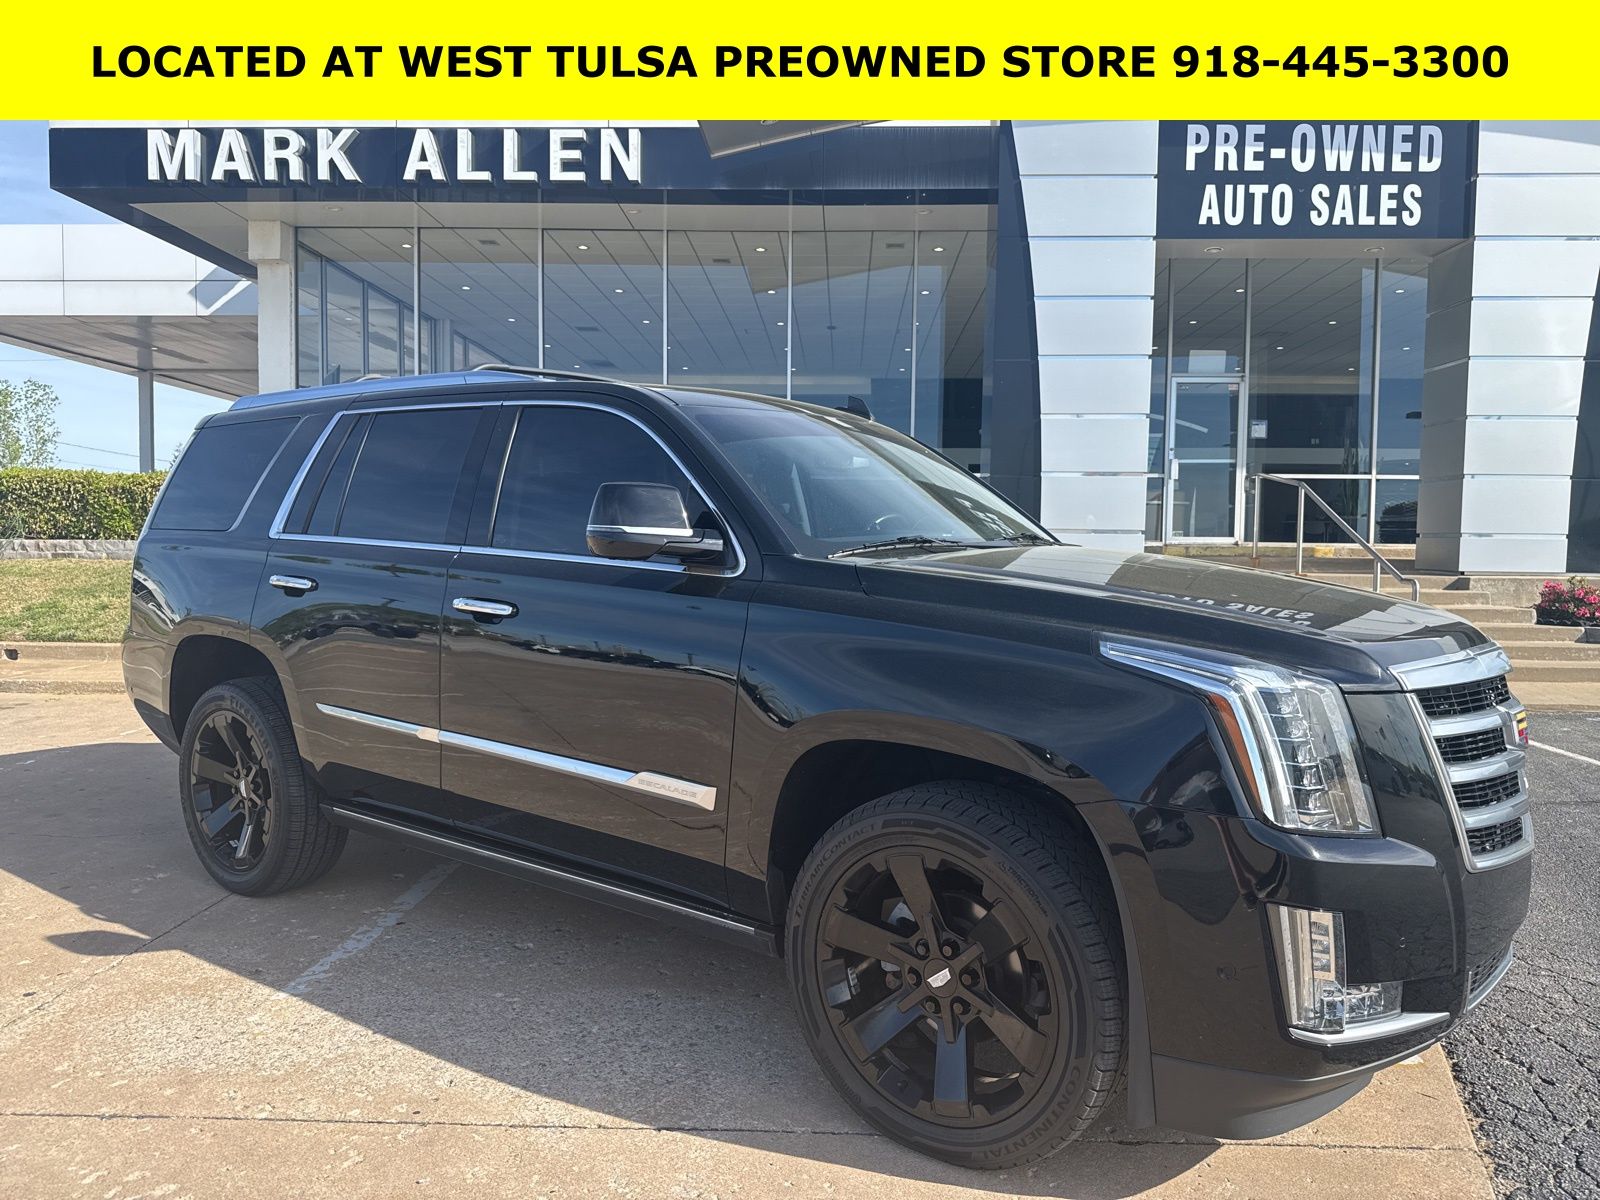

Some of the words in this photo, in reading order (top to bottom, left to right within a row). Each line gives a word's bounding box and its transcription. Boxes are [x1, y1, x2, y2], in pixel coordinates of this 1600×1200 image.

[147, 128, 363, 184] MARK
[402, 128, 642, 185] ALLEN
[1185, 123, 1443, 173] PRE-OWNED
[1198, 183, 1294, 226] AUTO
[1309, 183, 1423, 227] SALES
[638, 778, 697, 799] ESCALADE
[983, 1065, 1081, 1160] CONTINENTAL
